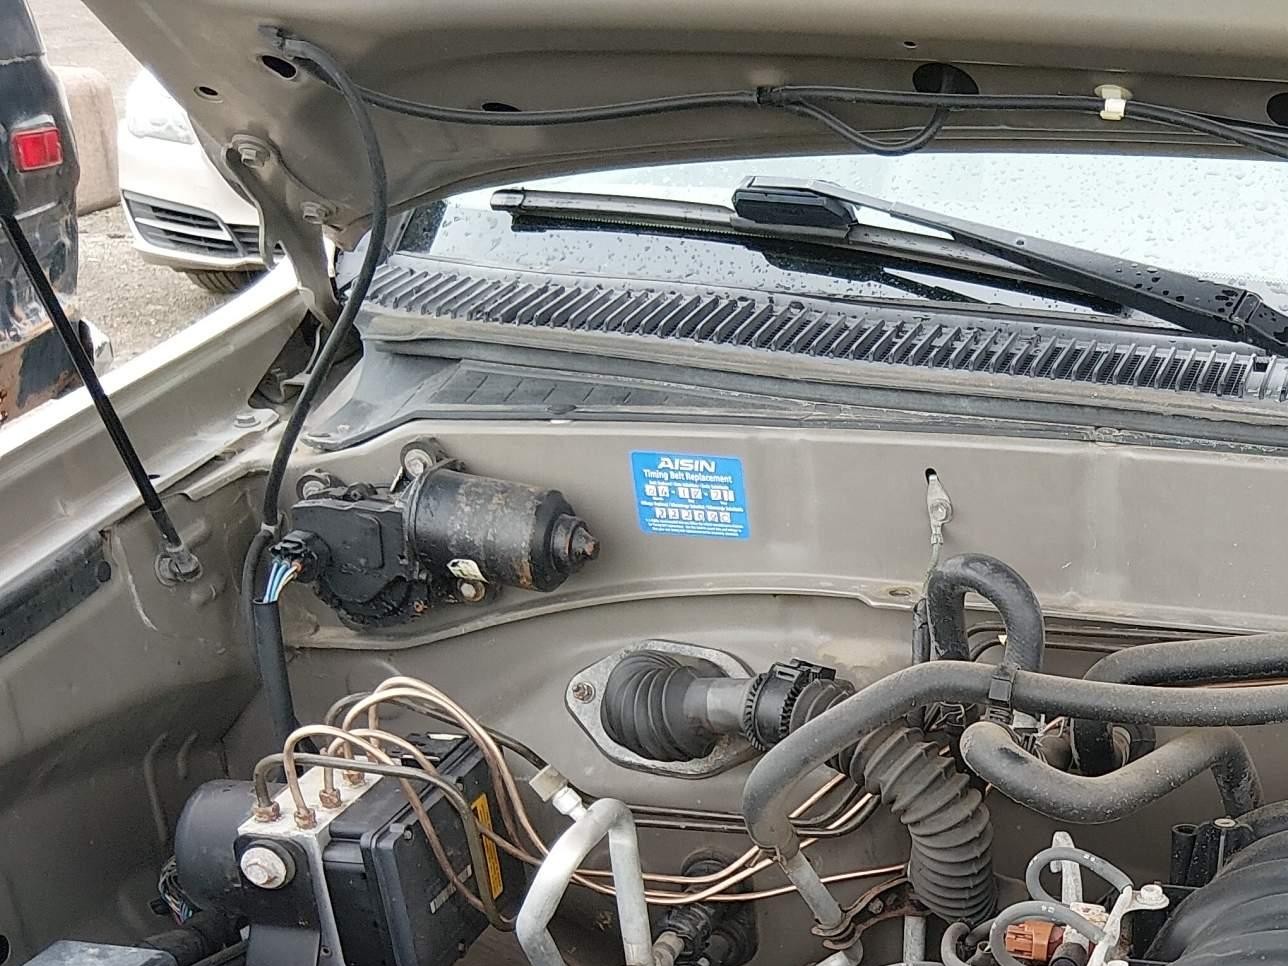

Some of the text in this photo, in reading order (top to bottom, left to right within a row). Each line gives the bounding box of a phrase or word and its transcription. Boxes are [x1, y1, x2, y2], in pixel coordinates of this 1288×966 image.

[658, 457, 716, 473] AISIN
[643, 469, 669, 481] Timing
[686, 472, 733, 484] Replacement
